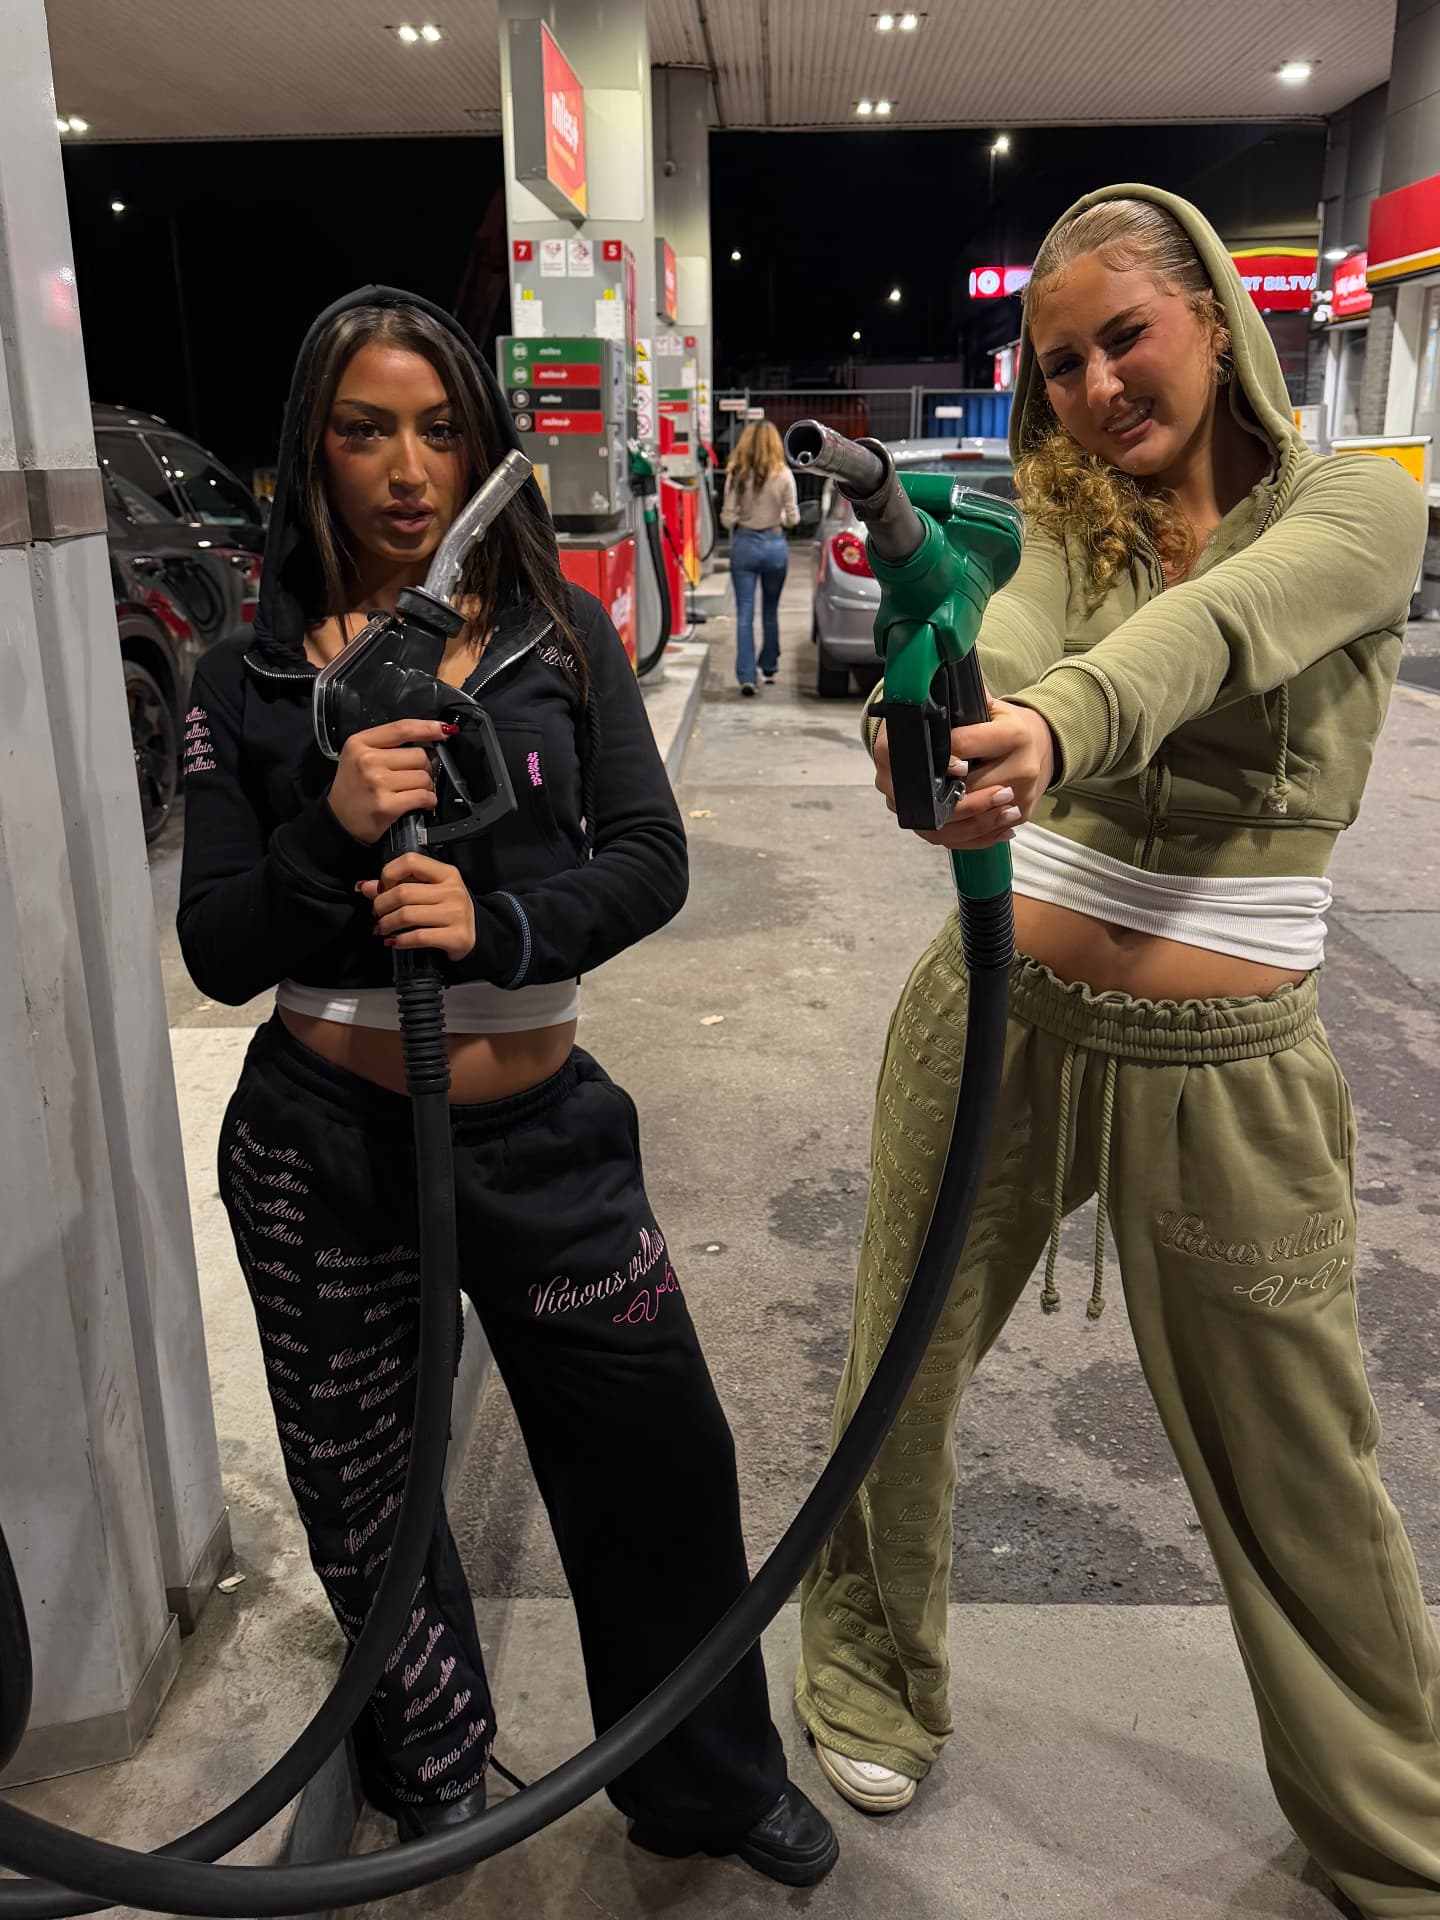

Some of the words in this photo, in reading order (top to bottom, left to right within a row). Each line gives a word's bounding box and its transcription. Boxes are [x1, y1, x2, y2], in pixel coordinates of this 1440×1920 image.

[518, 245, 527, 257] 7
[608, 244, 617, 257] 5
[255, 1198, 306, 1223] villain
[1157, 1211, 1266, 1265] Vicious
[1264, 1212, 1346, 1263] villain
[314, 1247, 370, 1269] Vicious
[527, 1275, 627, 1319] Vicious
[627, 1226, 666, 1283] villain
[316, 1279, 372, 1301] Vicious
[328, 1345, 378, 1371] Vicious
[308, 1378, 361, 1401] Vicious
[308, 1439, 359, 1460] Vicious
[339, 1451, 383, 1484] Vicious
[417, 1747, 461, 1783] Vicious
[436, 1771, 480, 1802] Vicious
